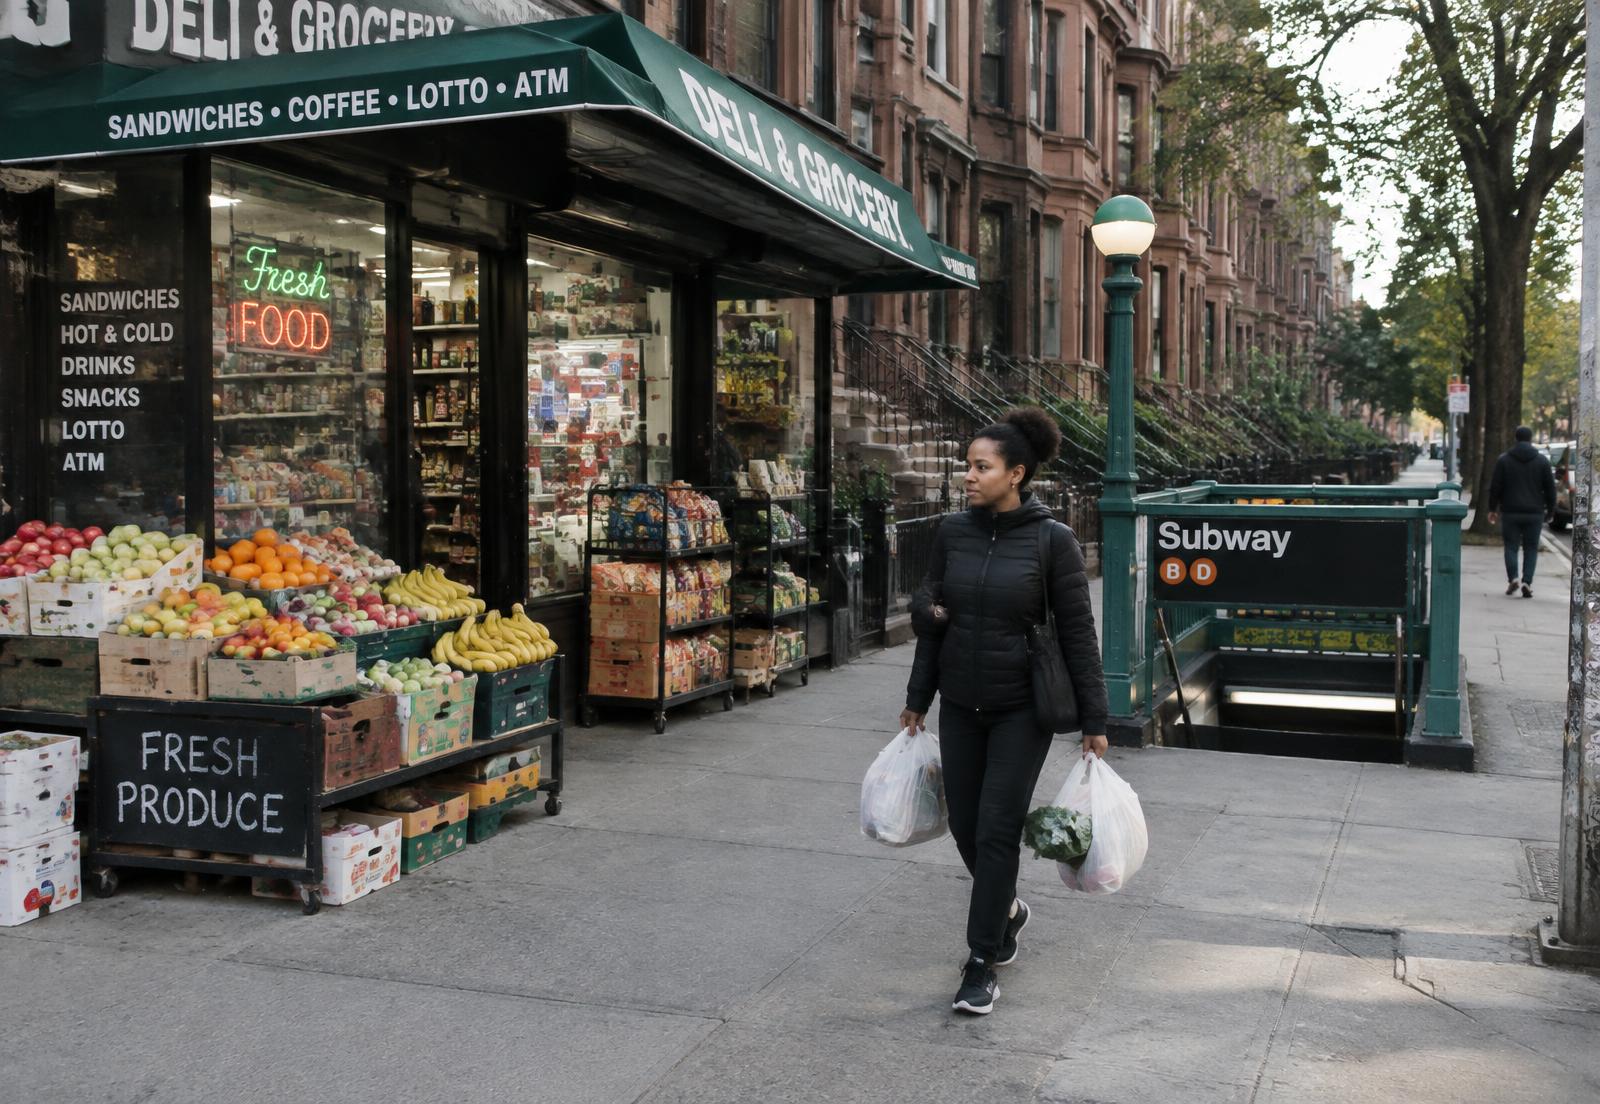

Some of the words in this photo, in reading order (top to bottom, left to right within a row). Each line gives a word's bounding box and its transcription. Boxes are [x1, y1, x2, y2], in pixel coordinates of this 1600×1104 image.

[131, 0, 240, 60] DELI
[254, 0, 279, 56] &
[108, 101, 263, 140] SANDWICHES
[287, 88, 381, 124] COFFEE
[406, 76, 489, 112] LOTTO
[514, 67, 570, 99] ATM
[678, 67, 773, 174] DELI
[772, 127, 799, 187] &
[243, 245, 330, 299] Fresh
[60, 288, 180, 313] SANDWICHES
[61, 325, 101, 344] HOT
[105, 324, 118, 343] &
[123, 322, 174, 343] COLD
[241, 301, 330, 350] FOOD
[61, 355, 136, 376] DRINKS
[61, 387, 141, 408] SNACKS
[62, 420, 125, 440] LOTTO
[63, 452, 105, 472] ATM
[1158, 521, 1292, 559] Subway
[1166, 563, 1181, 580] B
[1197, 563, 1212, 581] D
[141, 730, 259, 777] FRESH
[117, 781, 285, 834] PRODUCE
